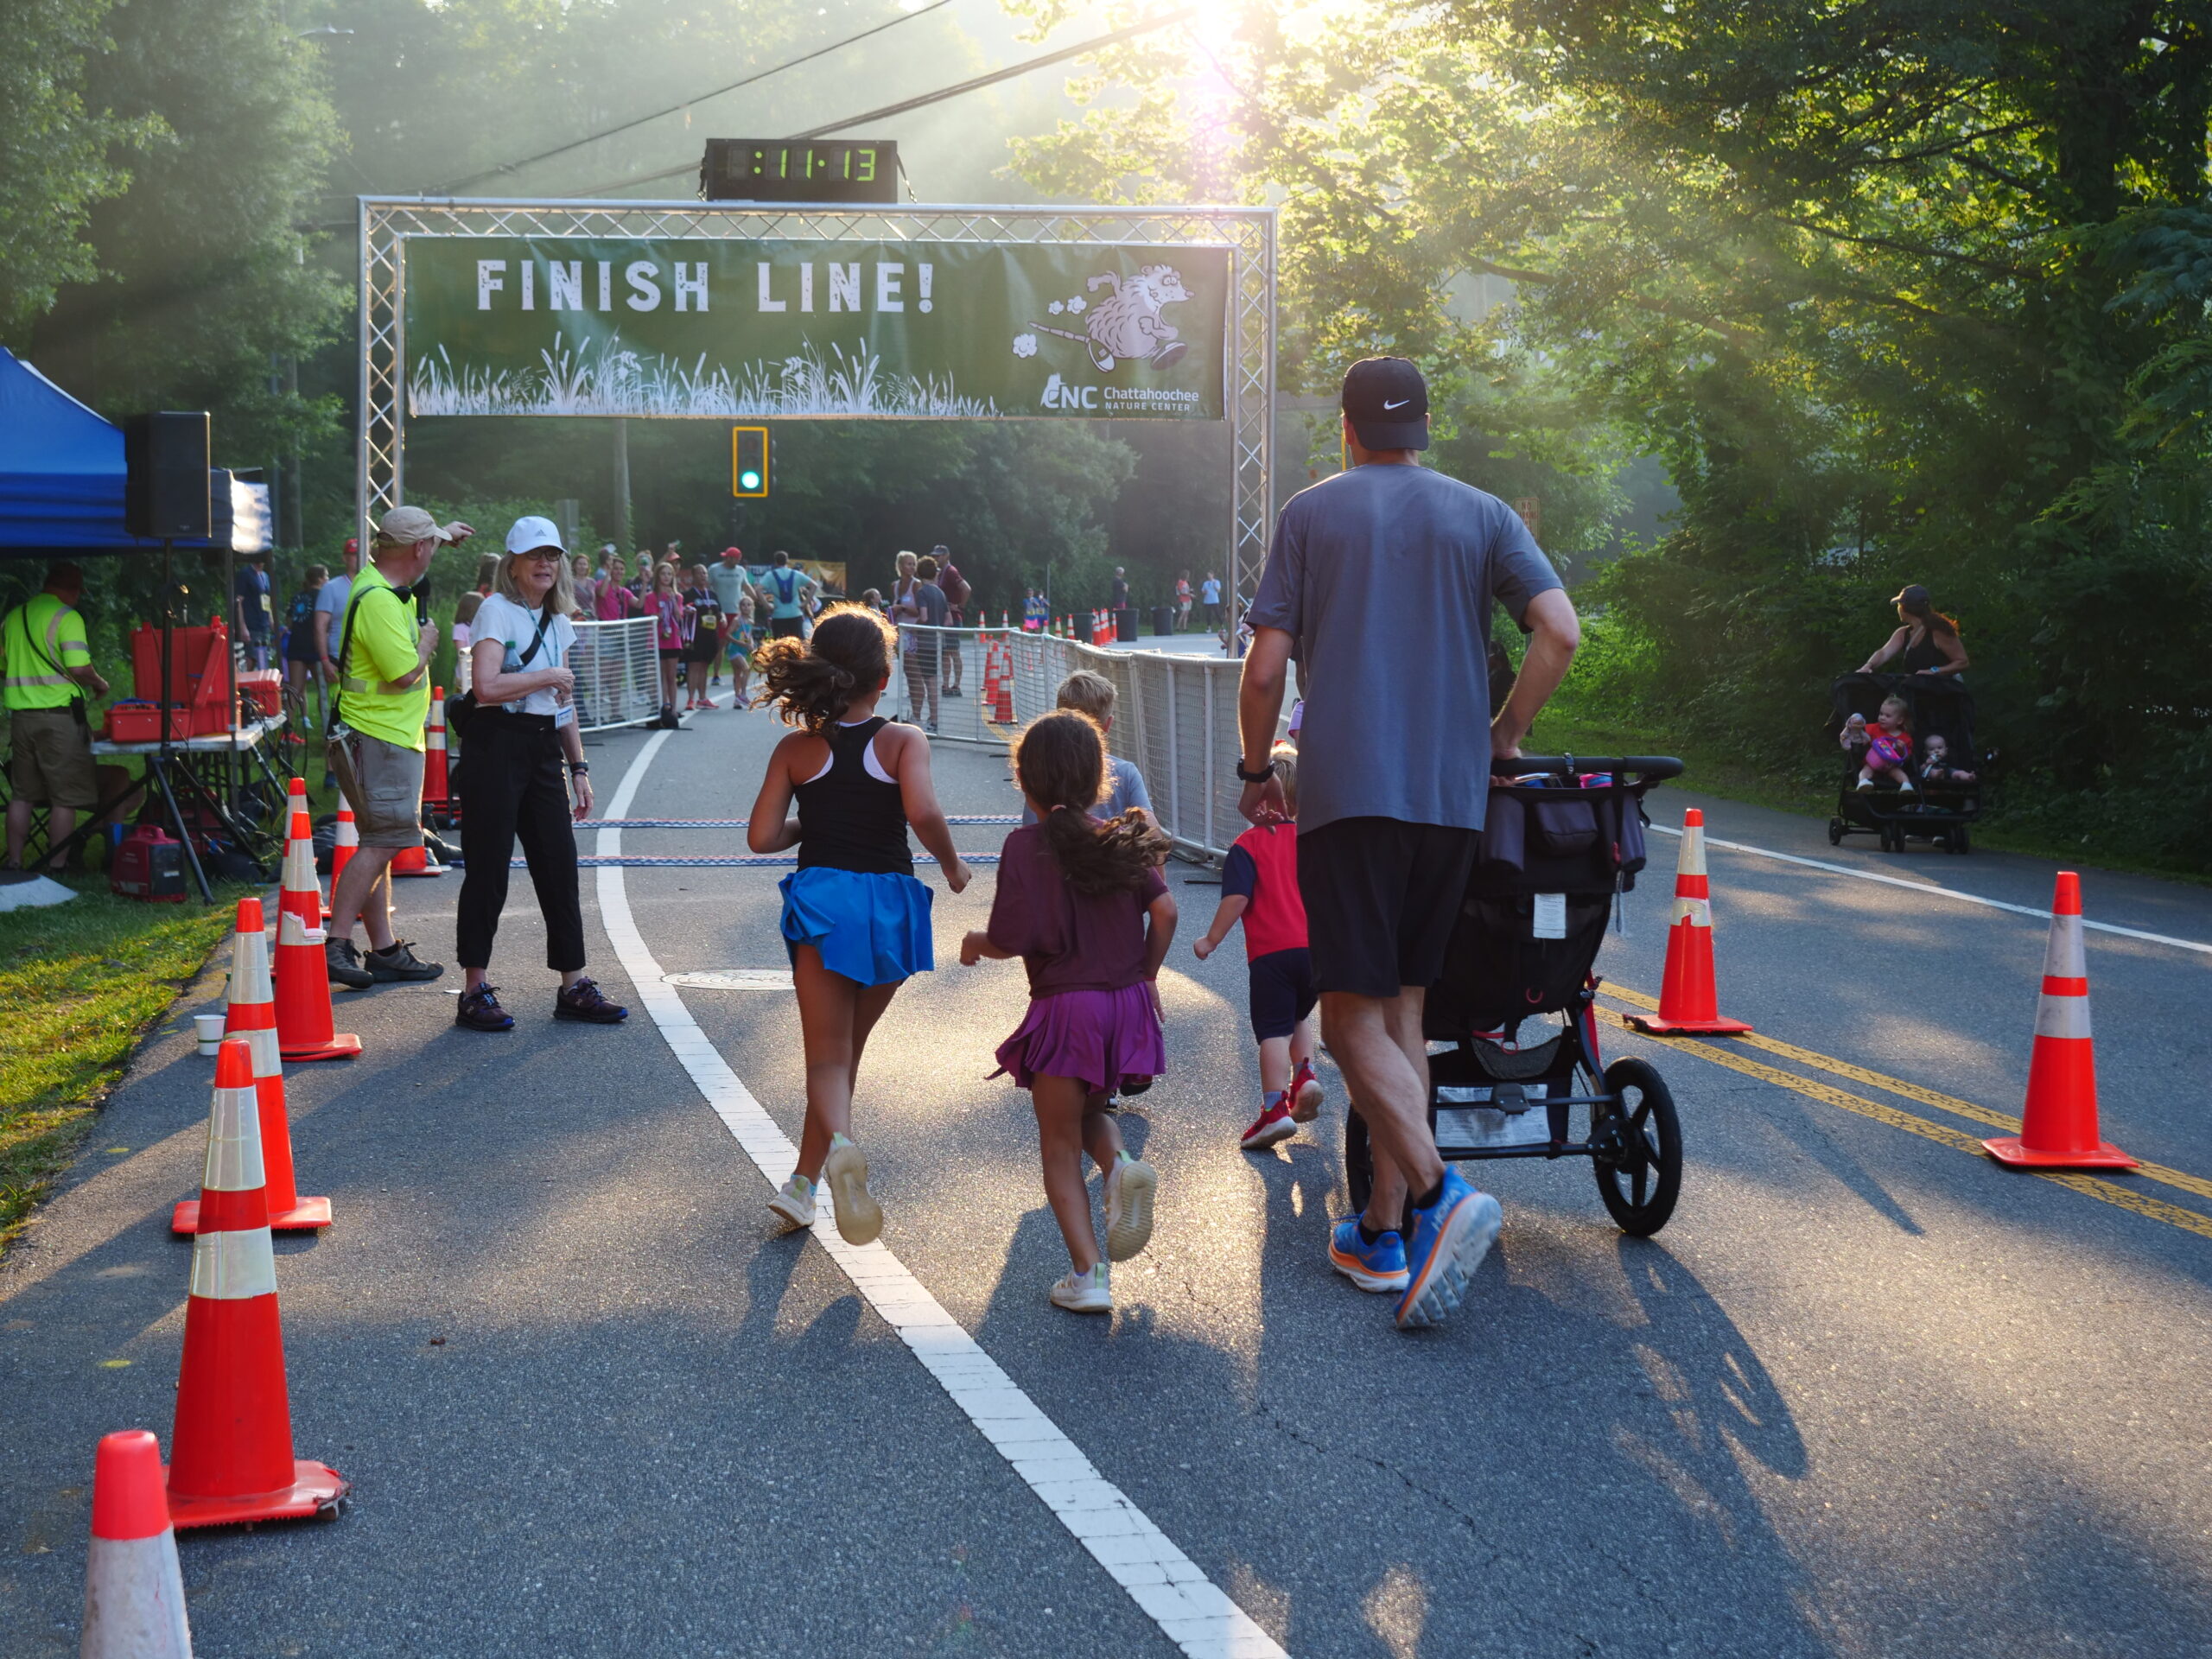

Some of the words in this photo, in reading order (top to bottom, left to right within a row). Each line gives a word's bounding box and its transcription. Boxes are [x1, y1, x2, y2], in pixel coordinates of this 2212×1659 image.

[476, 259, 709, 312] FINISH
[757, 262, 933, 314] LINE!
[1103, 386, 1199, 402] Chattahoochee
[1105, 402, 1147, 410] NATURE
[1151, 403, 1191, 412] CENTER
